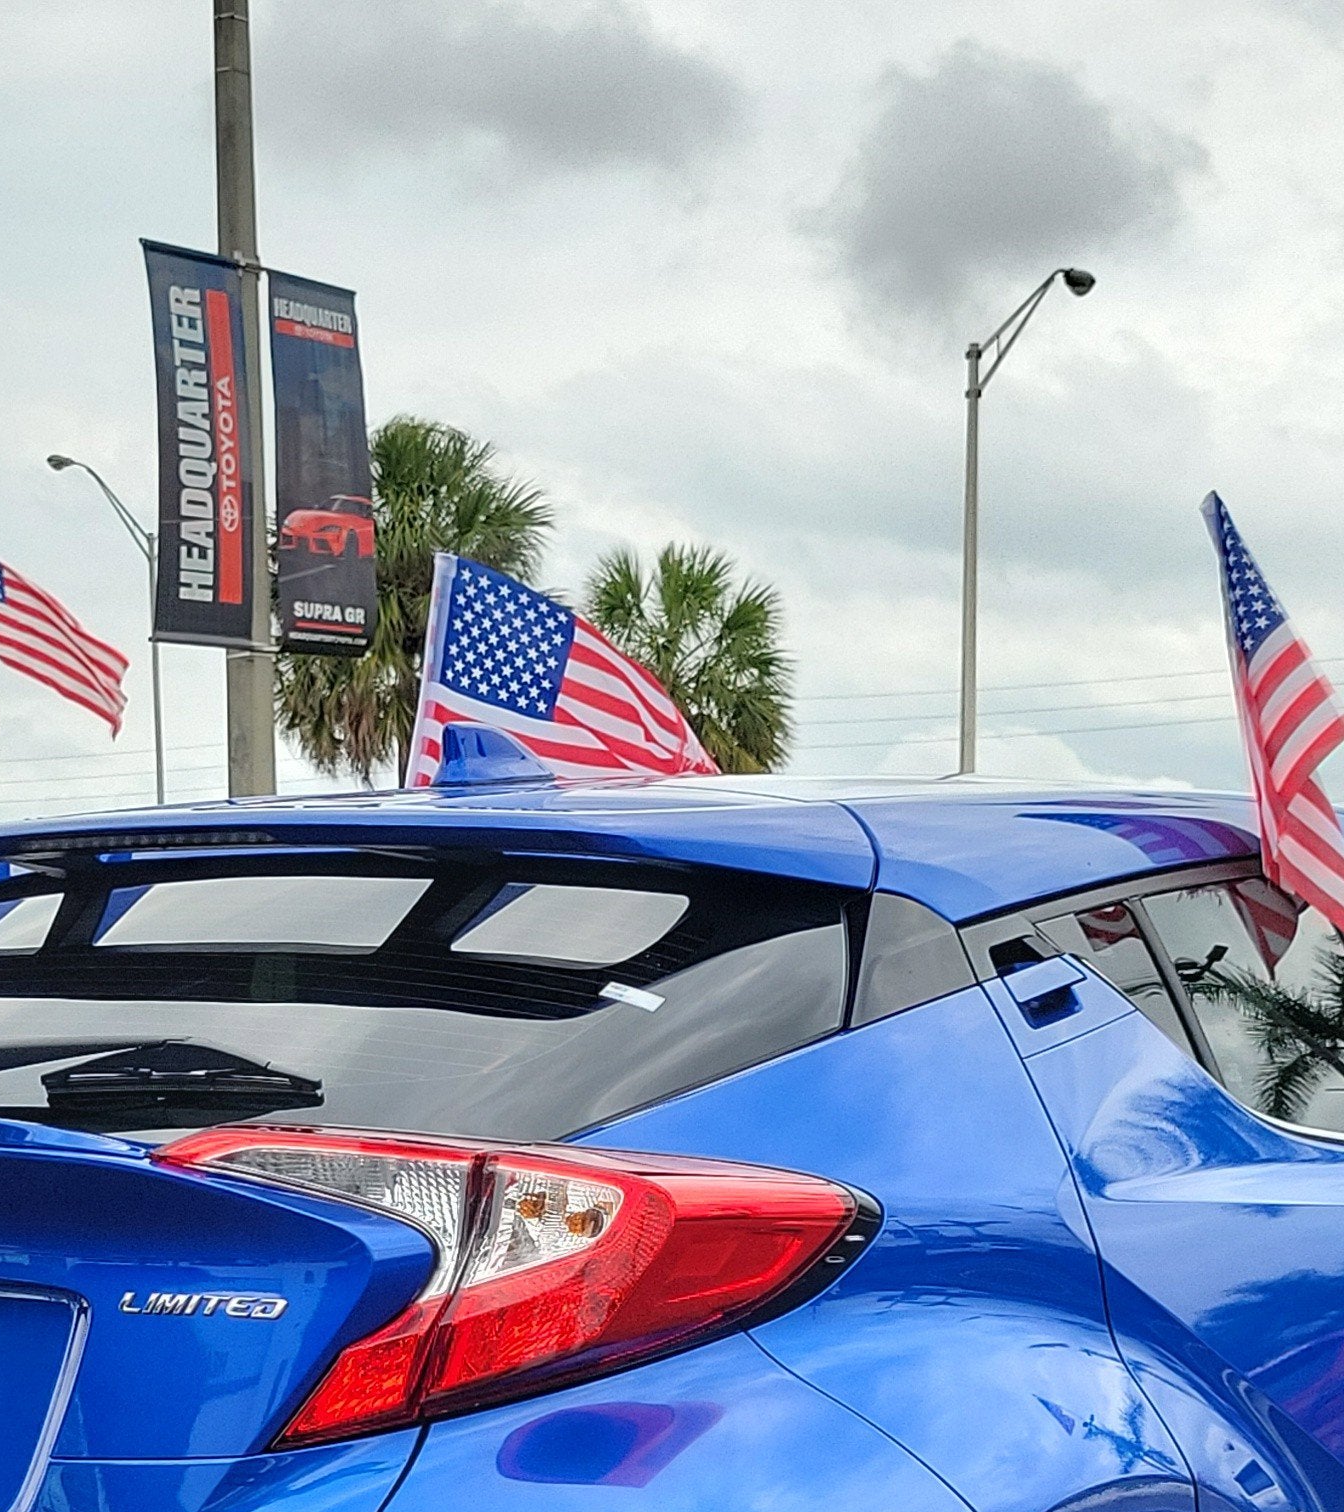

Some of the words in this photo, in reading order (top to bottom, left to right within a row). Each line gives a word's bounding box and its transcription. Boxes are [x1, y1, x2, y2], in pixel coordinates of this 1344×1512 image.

[273, 297, 352, 333] HEADQUARTER
[169, 285, 218, 602] HEADQUARTER
[215, 376, 238, 492] TOYOTA
[293, 600, 343, 622] SUPRA
[344, 606, 366, 625] GR
[118, 1291, 289, 1321] LIMITED
